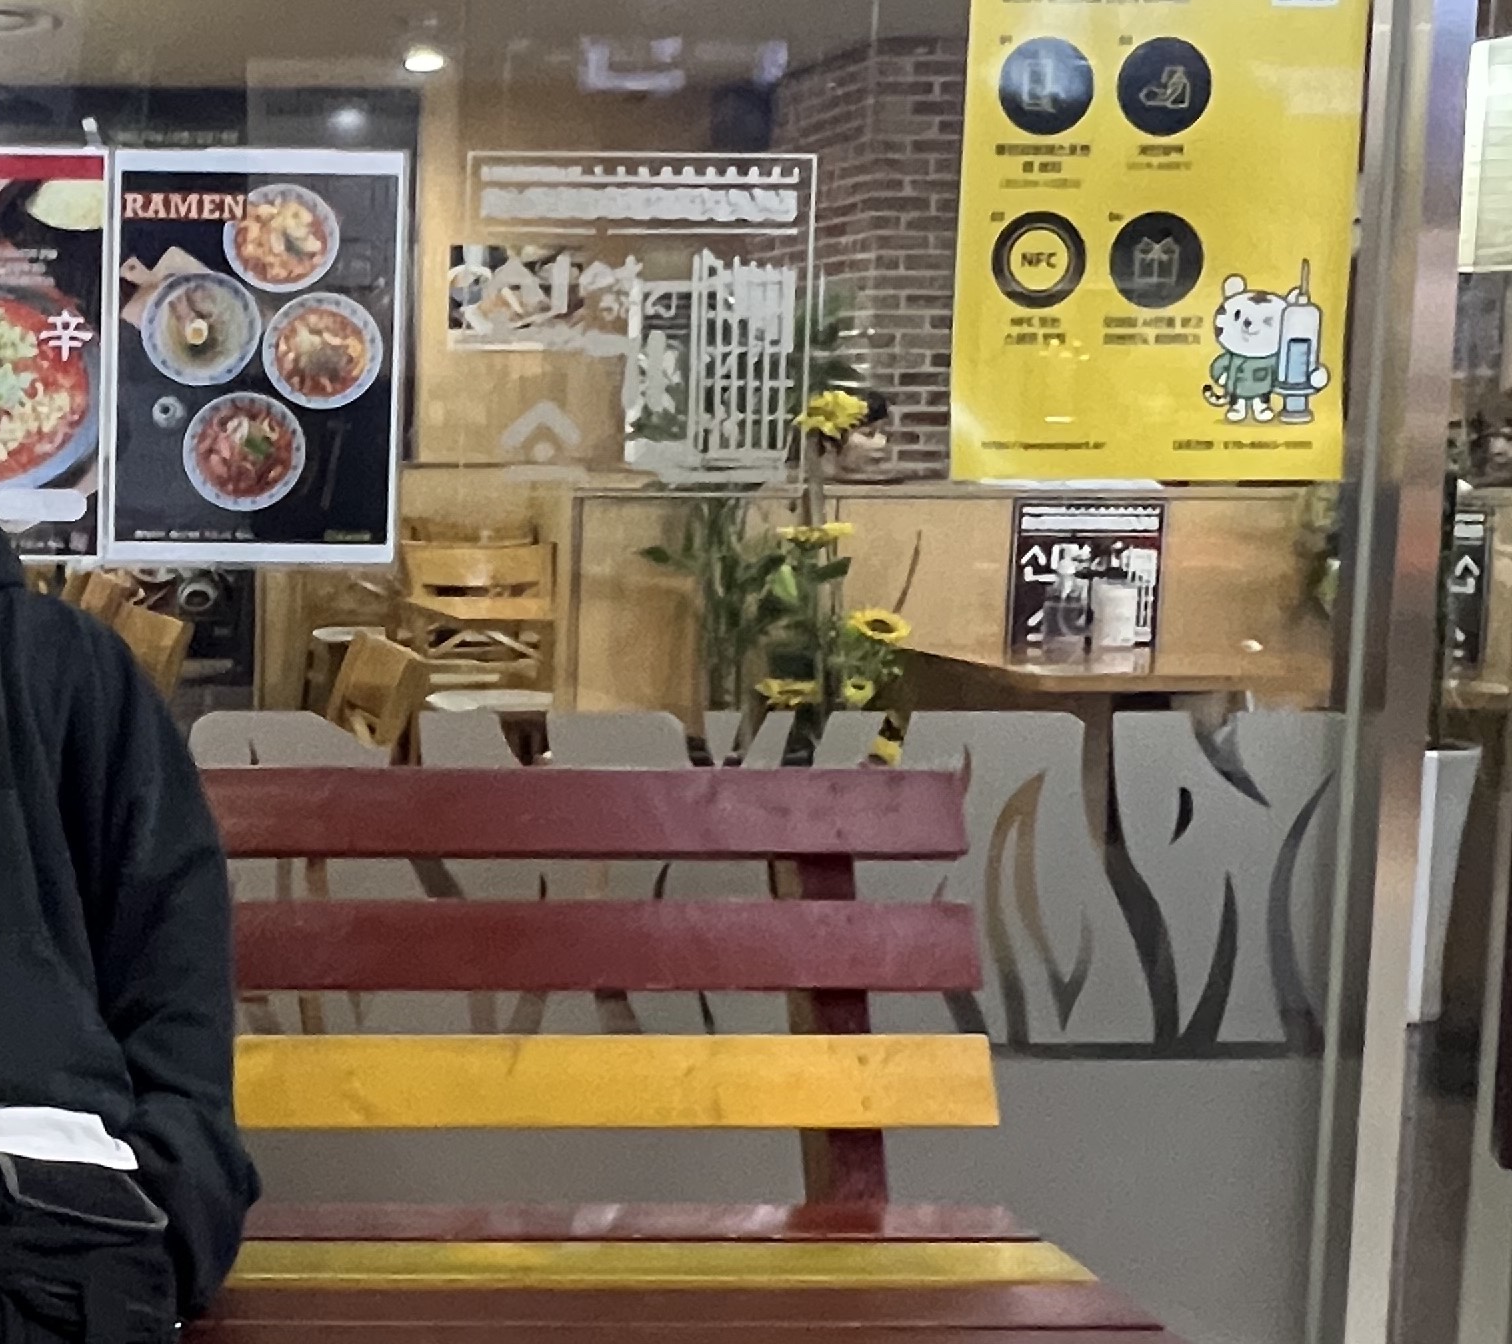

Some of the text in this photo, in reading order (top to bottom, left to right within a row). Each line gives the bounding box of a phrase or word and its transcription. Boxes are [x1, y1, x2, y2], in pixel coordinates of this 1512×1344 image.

[123, 192, 248, 222] RAMEN
[1020, 251, 1058, 270] NFC
[38, 308, 94, 362] 辛
